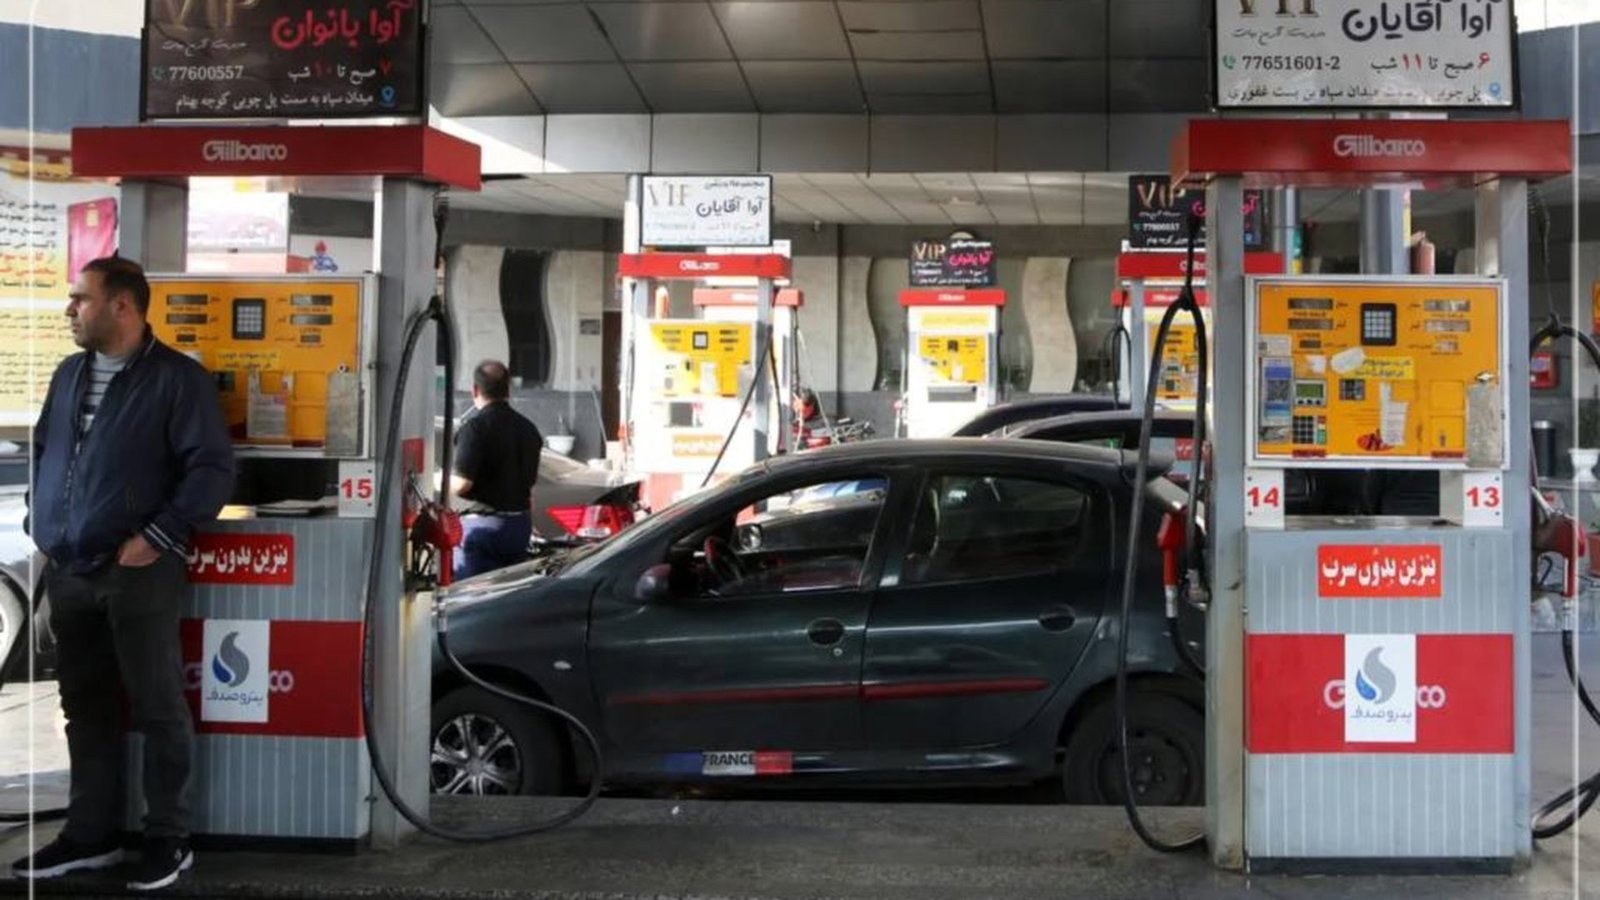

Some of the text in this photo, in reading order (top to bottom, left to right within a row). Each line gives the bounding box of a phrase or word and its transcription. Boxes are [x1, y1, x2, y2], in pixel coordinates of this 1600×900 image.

[272, 7, 359, 50] بانوان
[1242, 55, 1340, 70] 77651601-2
[1371, 57, 1397, 74] شب
[1428, 56, 1438, 70] تا
[1444, 61, 1474, 79] صبح
[169, 65, 244, 80] 77600557
[288, 66, 310, 82] شب
[350, 68, 376, 85] صبح
[203, 140, 288, 161] Gilbarco
[1333, 134, 1426, 156] Gilbarco
[914, 242, 946, 260] VIP
[341, 479, 372, 498] 15
[1247, 487, 1279, 508] 14
[1466, 487, 1500, 508] 13
[185, 544, 289, 574] بنزین بدون سرب
[1322, 553, 1437, 587] بنزین بدون سرب
[702, 753, 757, 765] FRANCE
